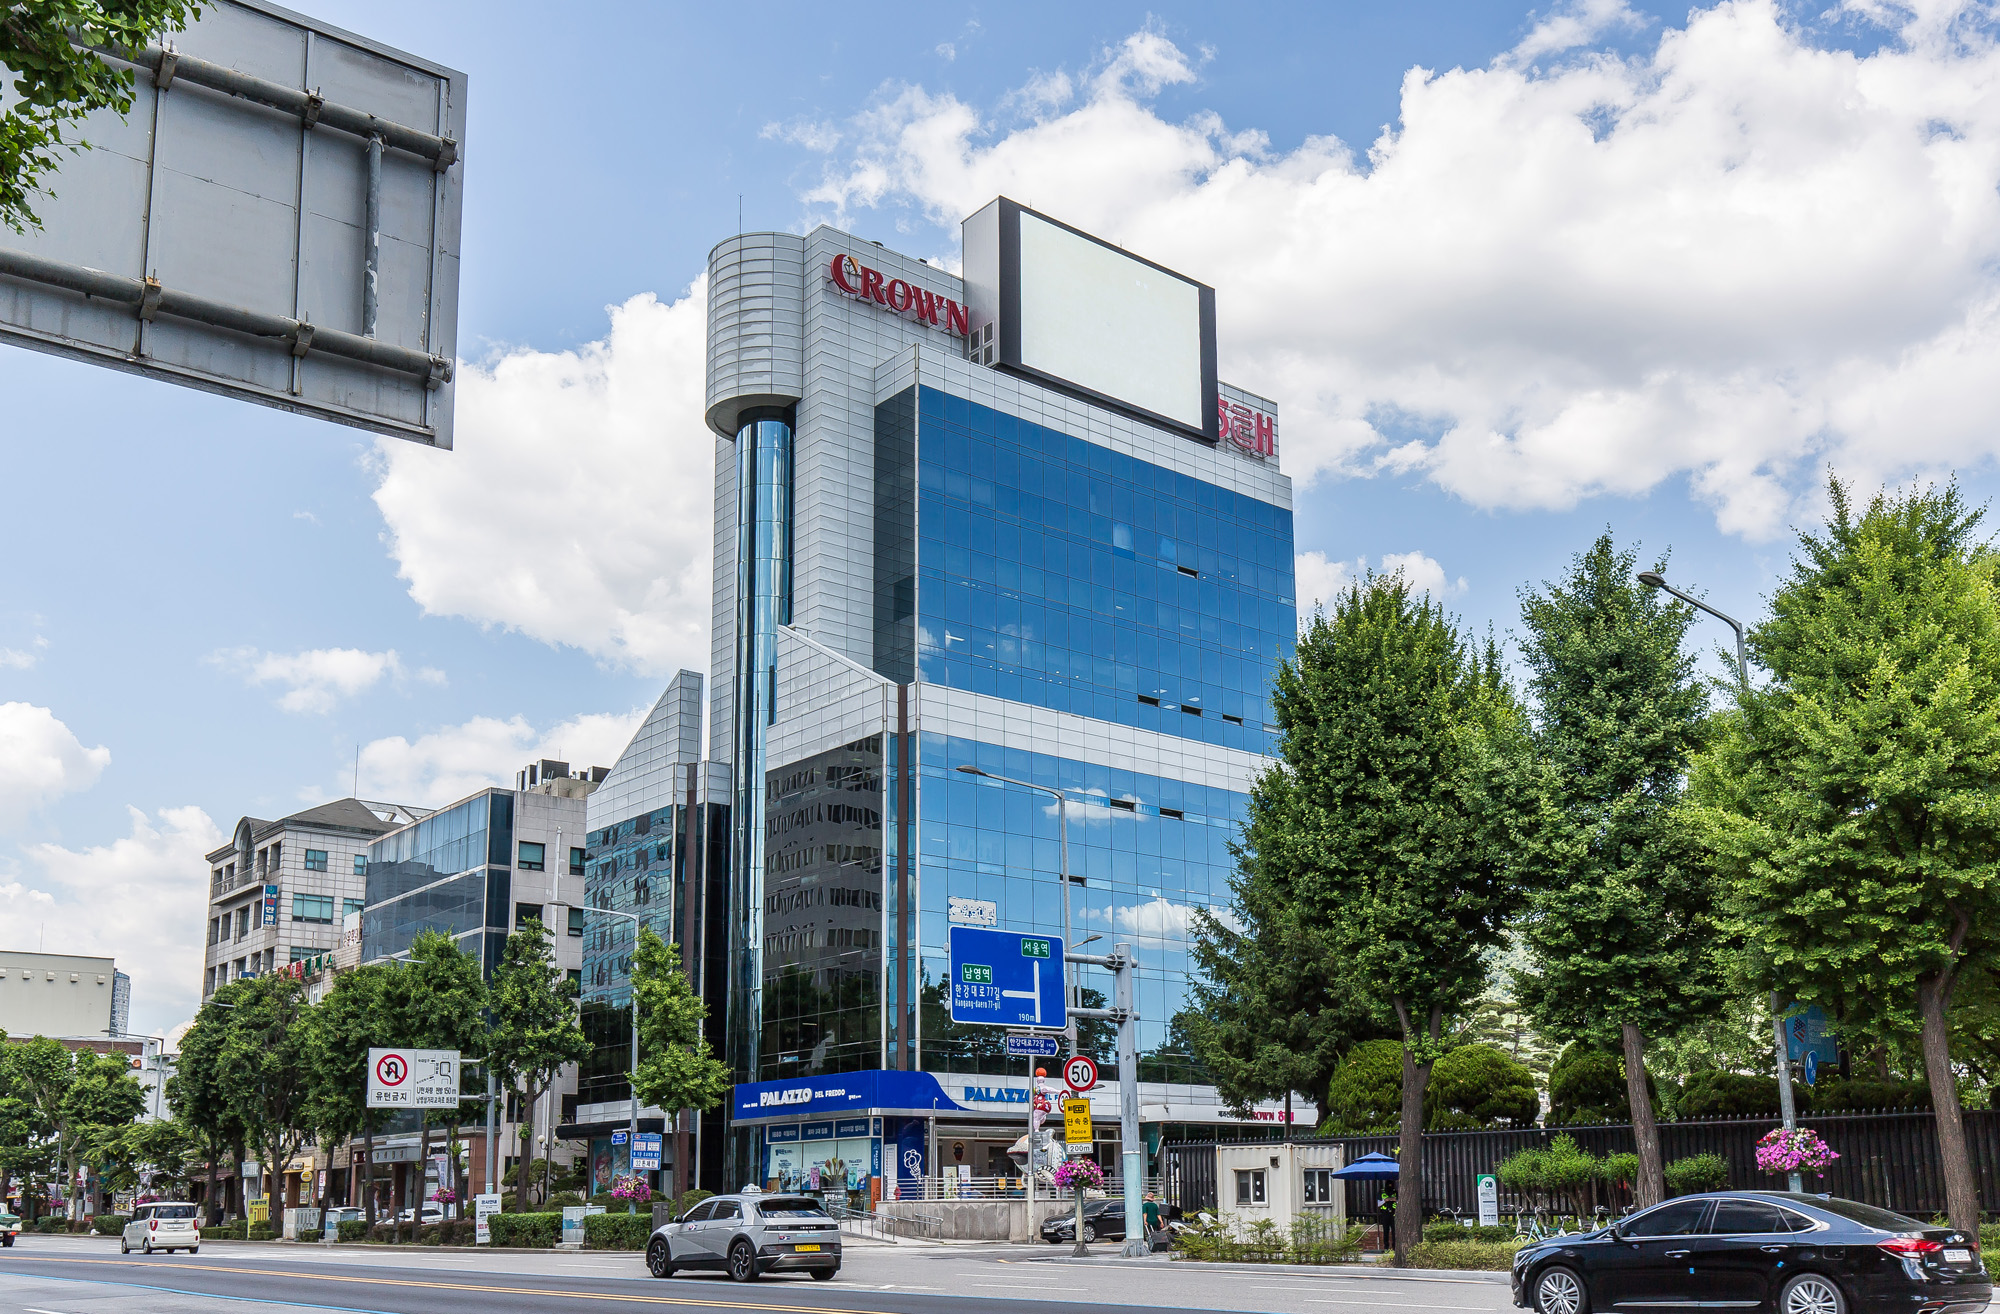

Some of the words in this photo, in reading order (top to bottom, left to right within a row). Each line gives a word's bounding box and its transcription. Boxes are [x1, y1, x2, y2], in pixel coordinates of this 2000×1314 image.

[830, 253, 969, 336] CROWN
[1024, 941, 1048, 955] 서울역
[964, 967, 990, 981] 남영역
[955, 983, 1000, 1001] 한강대로77길
[955, 999, 987, 1010] Hangang-daero
[987, 1000, 1001, 1010] 77-gil
[1018, 1013, 1035, 1022] 190m
[1009, 1038, 1045, 1048] 한강대로72길
[1071, 1065, 1090, 1083] 50
[375, 1091, 407, 1102] 유턴금지
[760, 1088, 812, 1107] PALAZZO
[825, 1089, 846, 1098] FREDDO
[1067, 1117, 1089, 1127] 단속중
